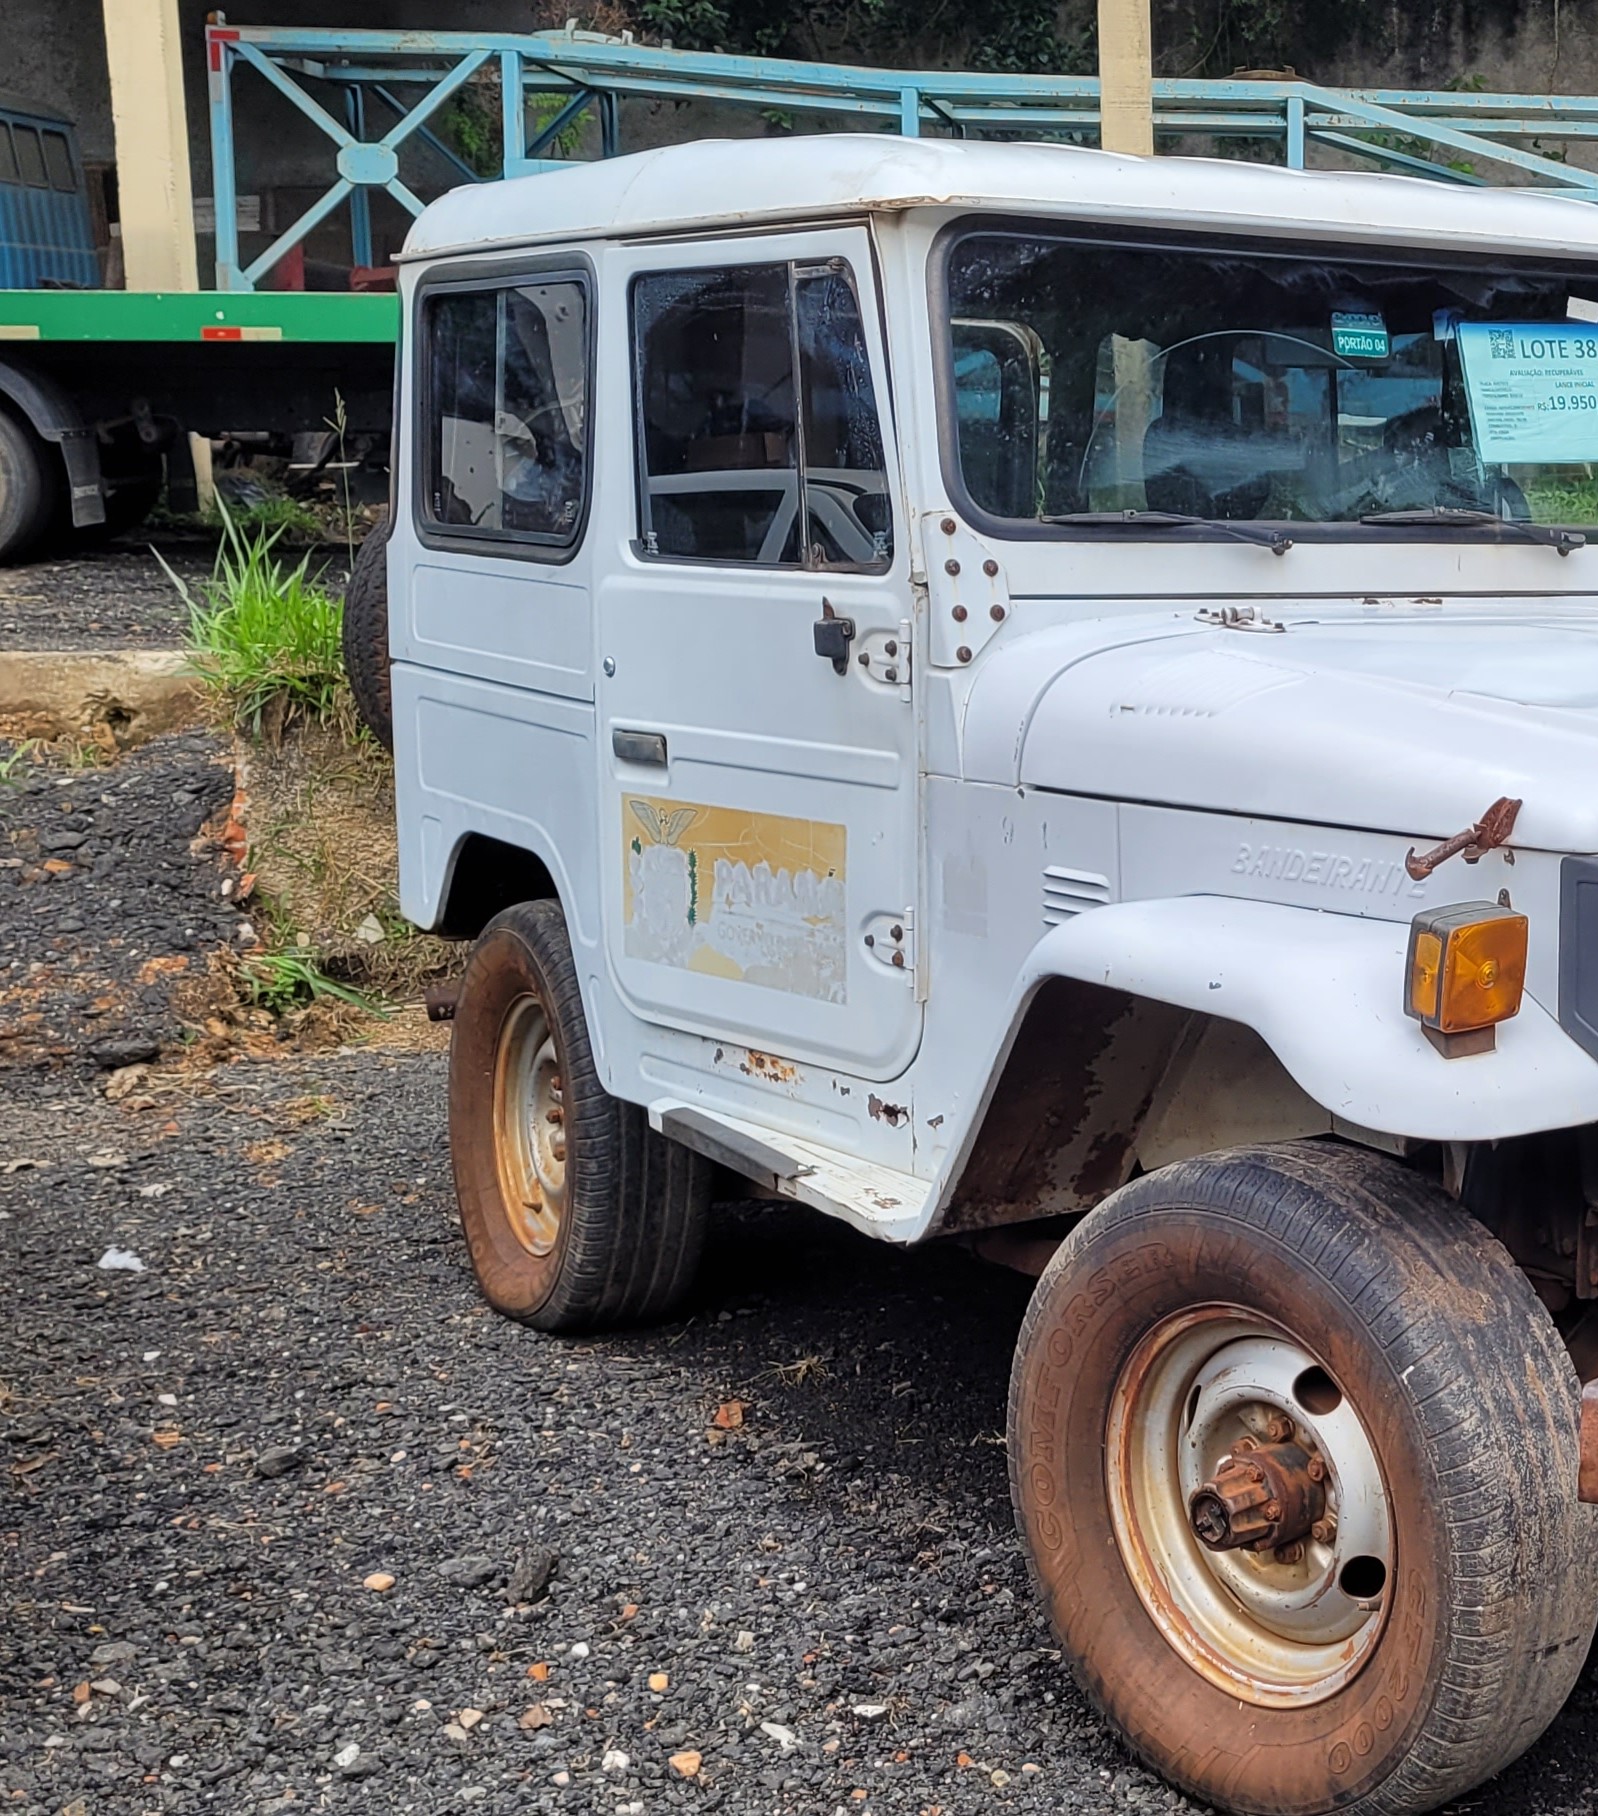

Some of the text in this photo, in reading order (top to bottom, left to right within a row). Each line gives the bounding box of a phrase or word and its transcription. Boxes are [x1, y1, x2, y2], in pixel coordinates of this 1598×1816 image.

[1338, 335, 1386, 352] PORTÃO 04
[1520, 339, 1598, 359] LOTE 38
[1030, 1242, 1176, 1551] COMFORSER
